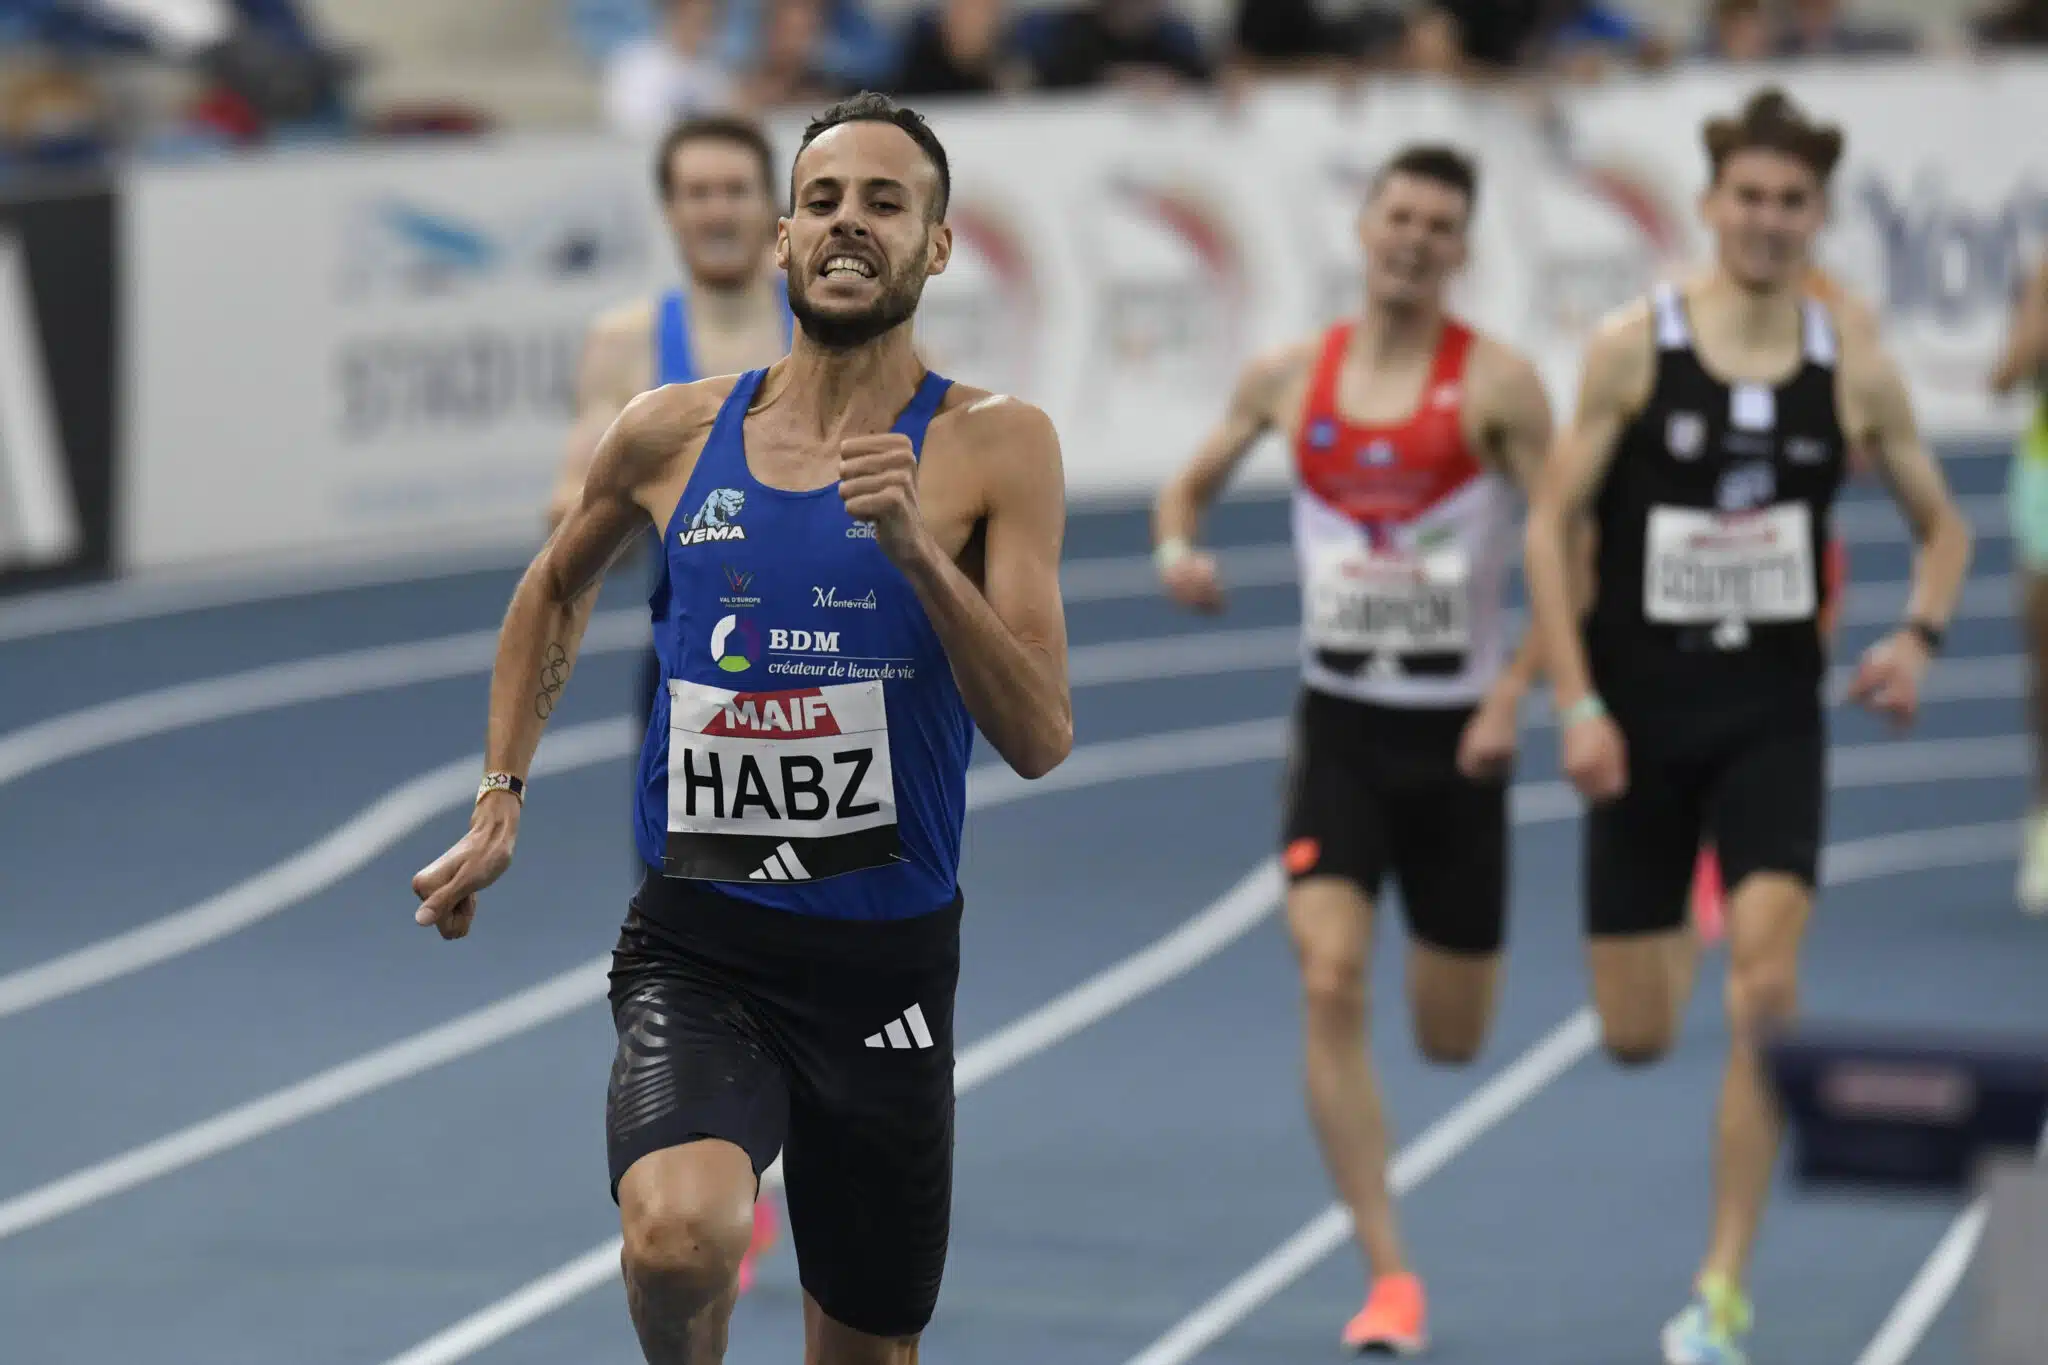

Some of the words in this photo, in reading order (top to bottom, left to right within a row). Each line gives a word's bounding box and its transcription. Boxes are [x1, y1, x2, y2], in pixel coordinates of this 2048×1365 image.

[679, 525, 745, 546] VEMA
[845, 524, 877, 539] adi
[768, 628, 840, 653] BDM
[768, 660, 826, 676] créateur
[827, 661, 845, 678] de
[847, 662, 880, 679] lieux
[880, 663, 896, 679] de
[897, 665, 915, 679] vie
[723, 695, 828, 732] MAIF
[683, 747, 880, 821] HABZ
